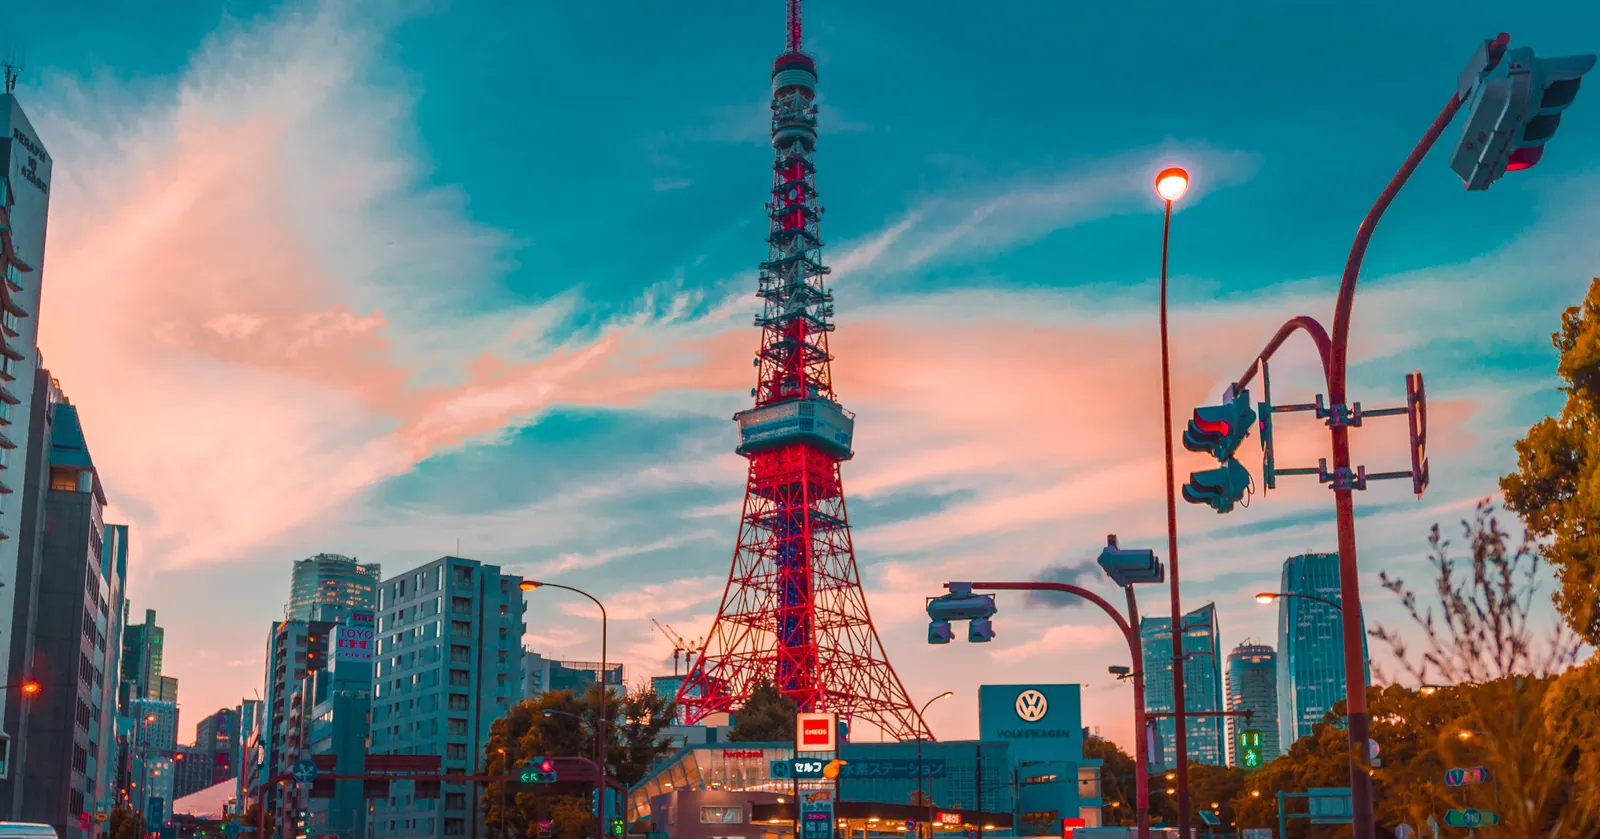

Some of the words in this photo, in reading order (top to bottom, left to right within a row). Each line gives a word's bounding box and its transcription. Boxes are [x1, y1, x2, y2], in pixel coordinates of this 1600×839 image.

[340, 627, 374, 639] TOYO
[996, 729, 1070, 739] VOLKSWAGEN
[794, 761, 822, 773] セルフ
[942, 812, 960, 824] ENEOS
